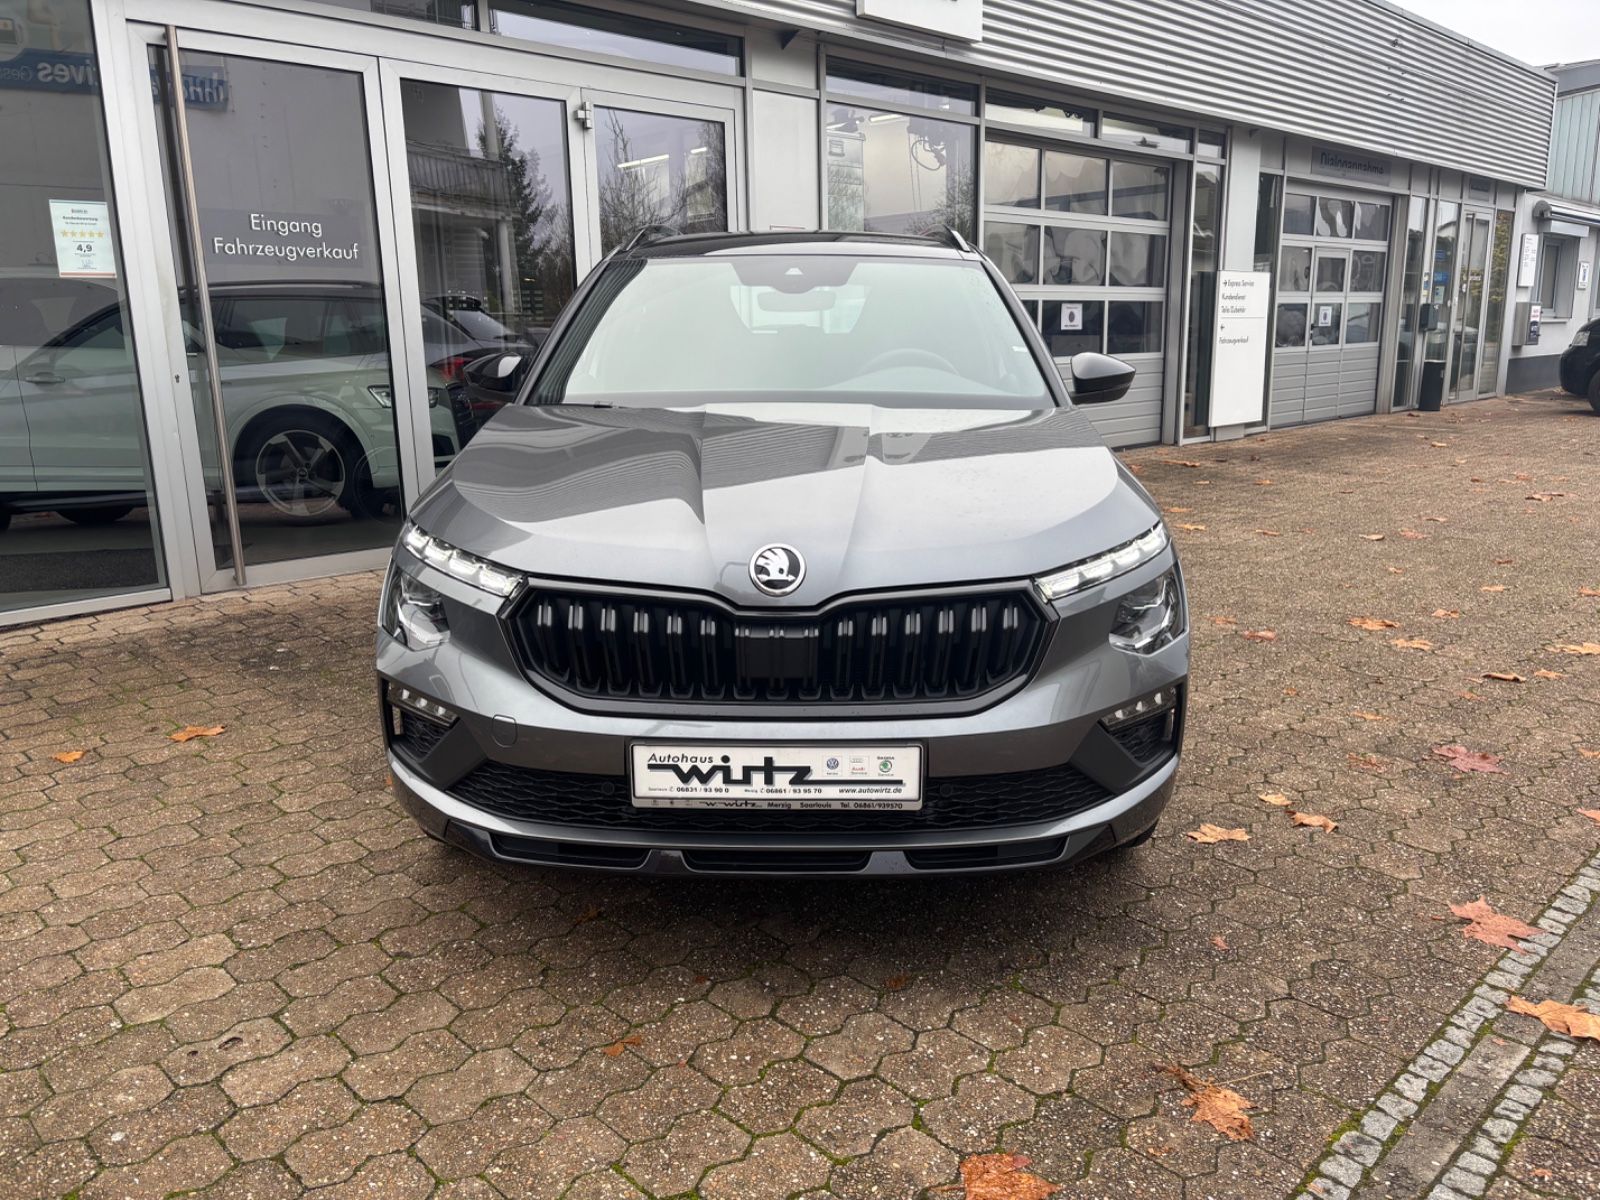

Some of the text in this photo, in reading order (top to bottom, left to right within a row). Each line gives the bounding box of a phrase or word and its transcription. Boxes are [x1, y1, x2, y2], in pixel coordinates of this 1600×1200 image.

[250, 213, 322, 238] Eingang
[76, 244, 93, 253] 4,9
[213, 237, 359, 262] Fahrzeugverkauf
[647, 753, 714, 763] Autohaus
